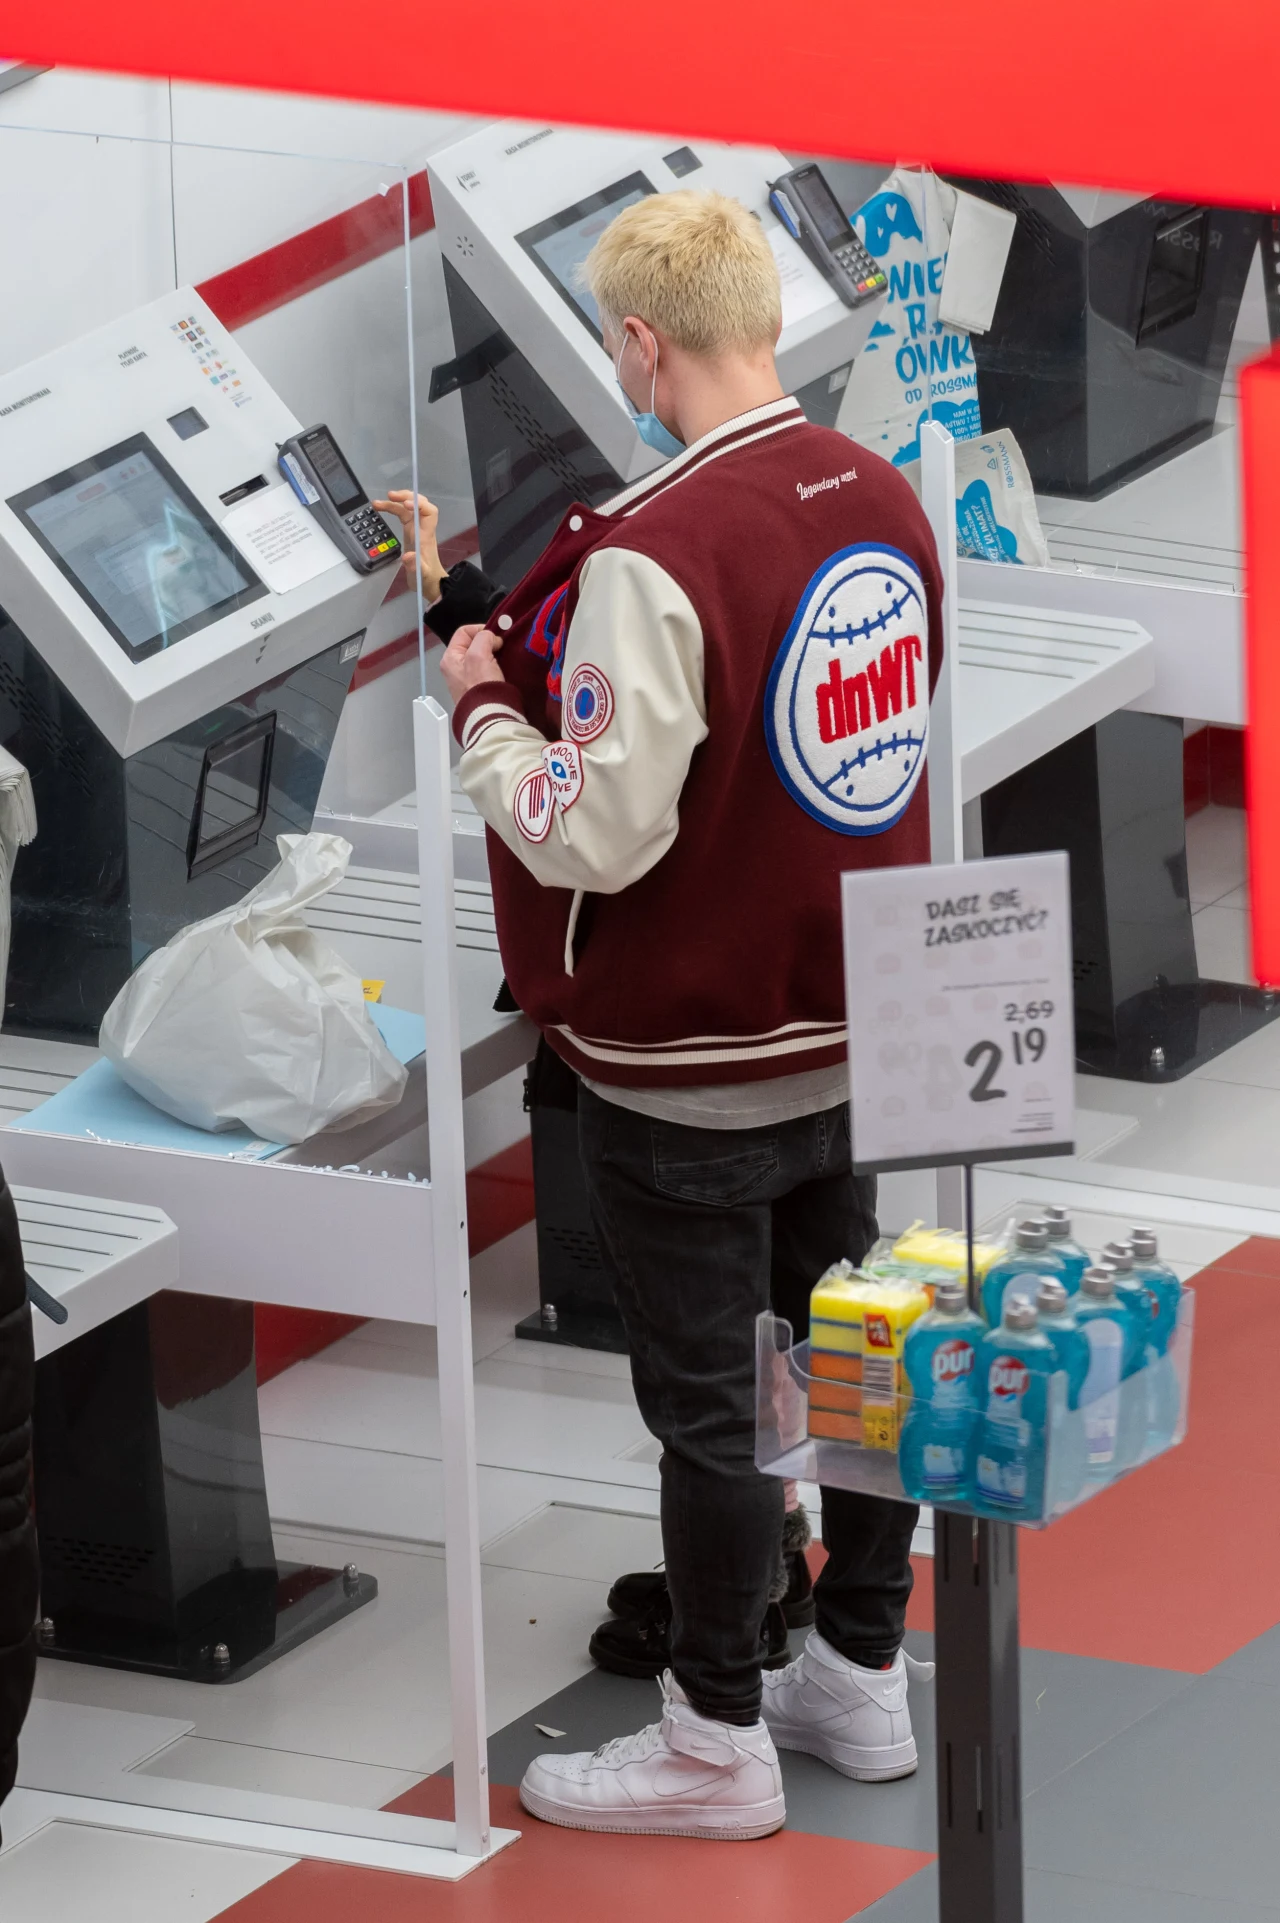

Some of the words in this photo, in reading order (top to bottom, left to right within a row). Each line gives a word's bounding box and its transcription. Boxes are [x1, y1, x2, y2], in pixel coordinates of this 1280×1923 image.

[905, 387, 922, 404] OD
[250, 612, 276, 630] SKANUJ
[549, 746, 578, 780] MOOVE
[925, 894, 981, 921] DASZ
[933, 1349, 975, 1382] pur
[988, 1366, 1029, 1394] pur
